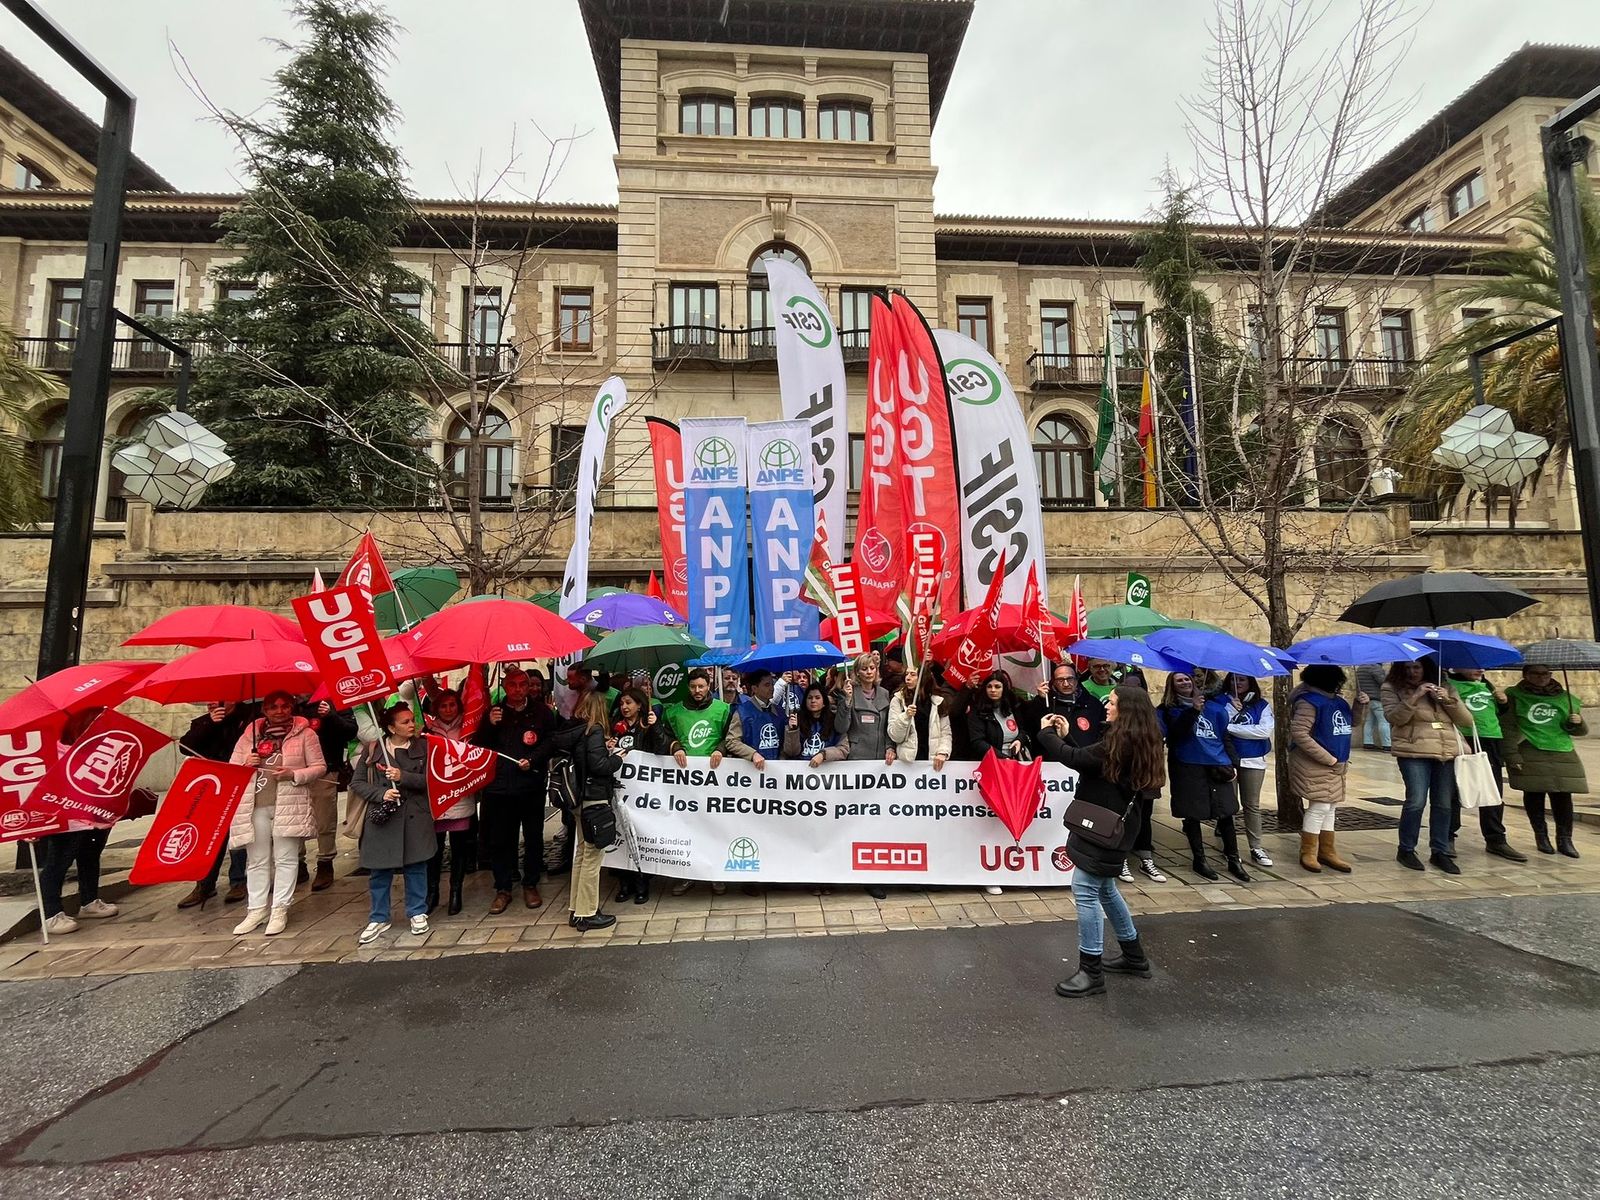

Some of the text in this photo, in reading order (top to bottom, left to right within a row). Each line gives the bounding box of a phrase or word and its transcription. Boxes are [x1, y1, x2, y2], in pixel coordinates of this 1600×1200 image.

[690, 466, 738, 481] ANPE
[756, 468, 804, 483] ANPE
[698, 495, 734, 648] ANPE
[1132, 586, 1149, 600] CSIF
[831, 565, 863, 655] CCOO
[308, 592, 369, 673] UGT
[507, 642, 531, 652] U.G.T.
[361, 673, 375, 682] FSP
[658, 673, 684, 687] CSIF
[338, 679, 359, 691] UGT
[1534, 708, 1558, 717] CSIF
[691, 727, 713, 739] CSIF
[0, 731, 47, 807] UGT
[620, 762, 719, 787] DEFENSA
[726, 771, 751, 787] de
[759, 773, 777, 789] la
[785, 772, 907, 791] MOVILIDAD
[915, 774, 947, 790] del
[635, 793, 661, 810] de
[668, 794, 698, 812] los
[706, 797, 828, 817] RECURSOS
[834, 802, 881, 820] para
[889, 801, 998, 820] compensa
[3, 812, 26, 824] UGT
[659, 837, 691, 846] Sindical
[640, 854, 691, 867] Funcionarios
[858, 848, 922, 865] CCOO
[979, 845, 1044, 872] UGT
[724, 859, 760, 869] ANPE
